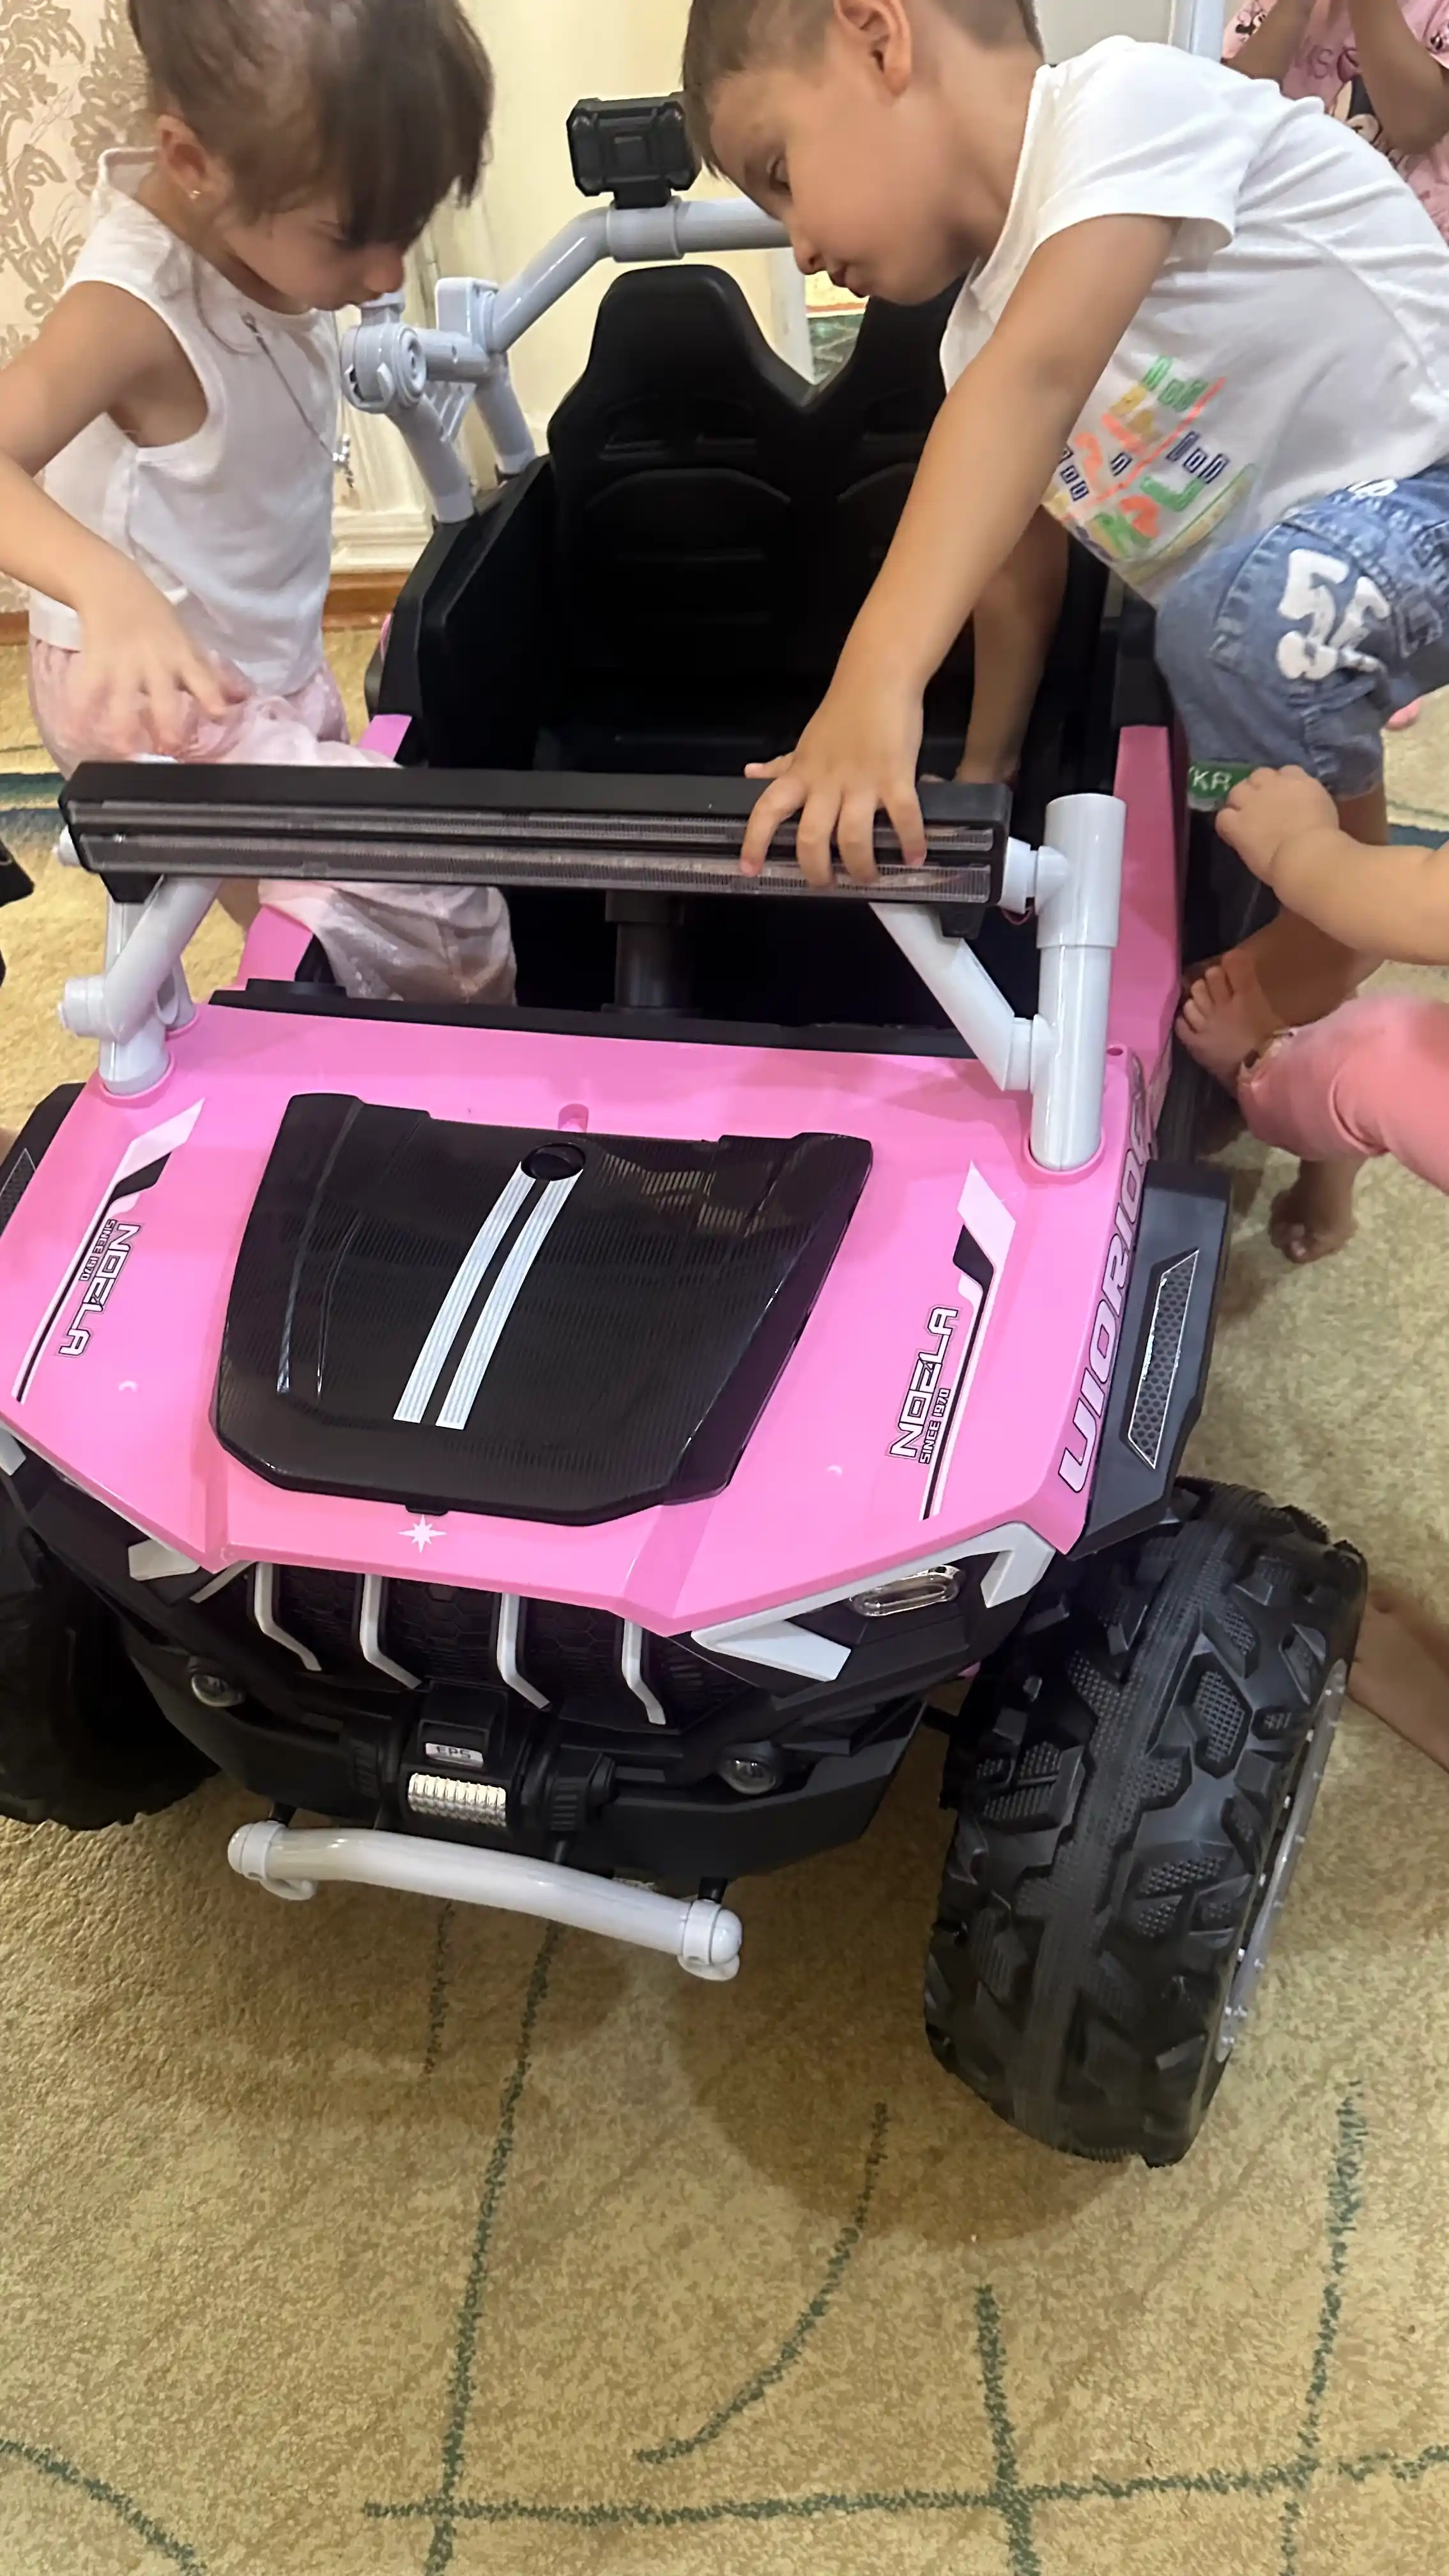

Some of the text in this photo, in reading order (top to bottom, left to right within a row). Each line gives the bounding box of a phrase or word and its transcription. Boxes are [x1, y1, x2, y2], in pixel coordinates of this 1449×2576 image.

[1189, 767, 1232, 791] KR
[58, 1223, 141, 1355] NOELA
[79, 1219, 118, 1282] SINCE 1970
[890, 1307, 959, 1457] NOELA
[918, 1388, 951, 1465] SINCE 1970
